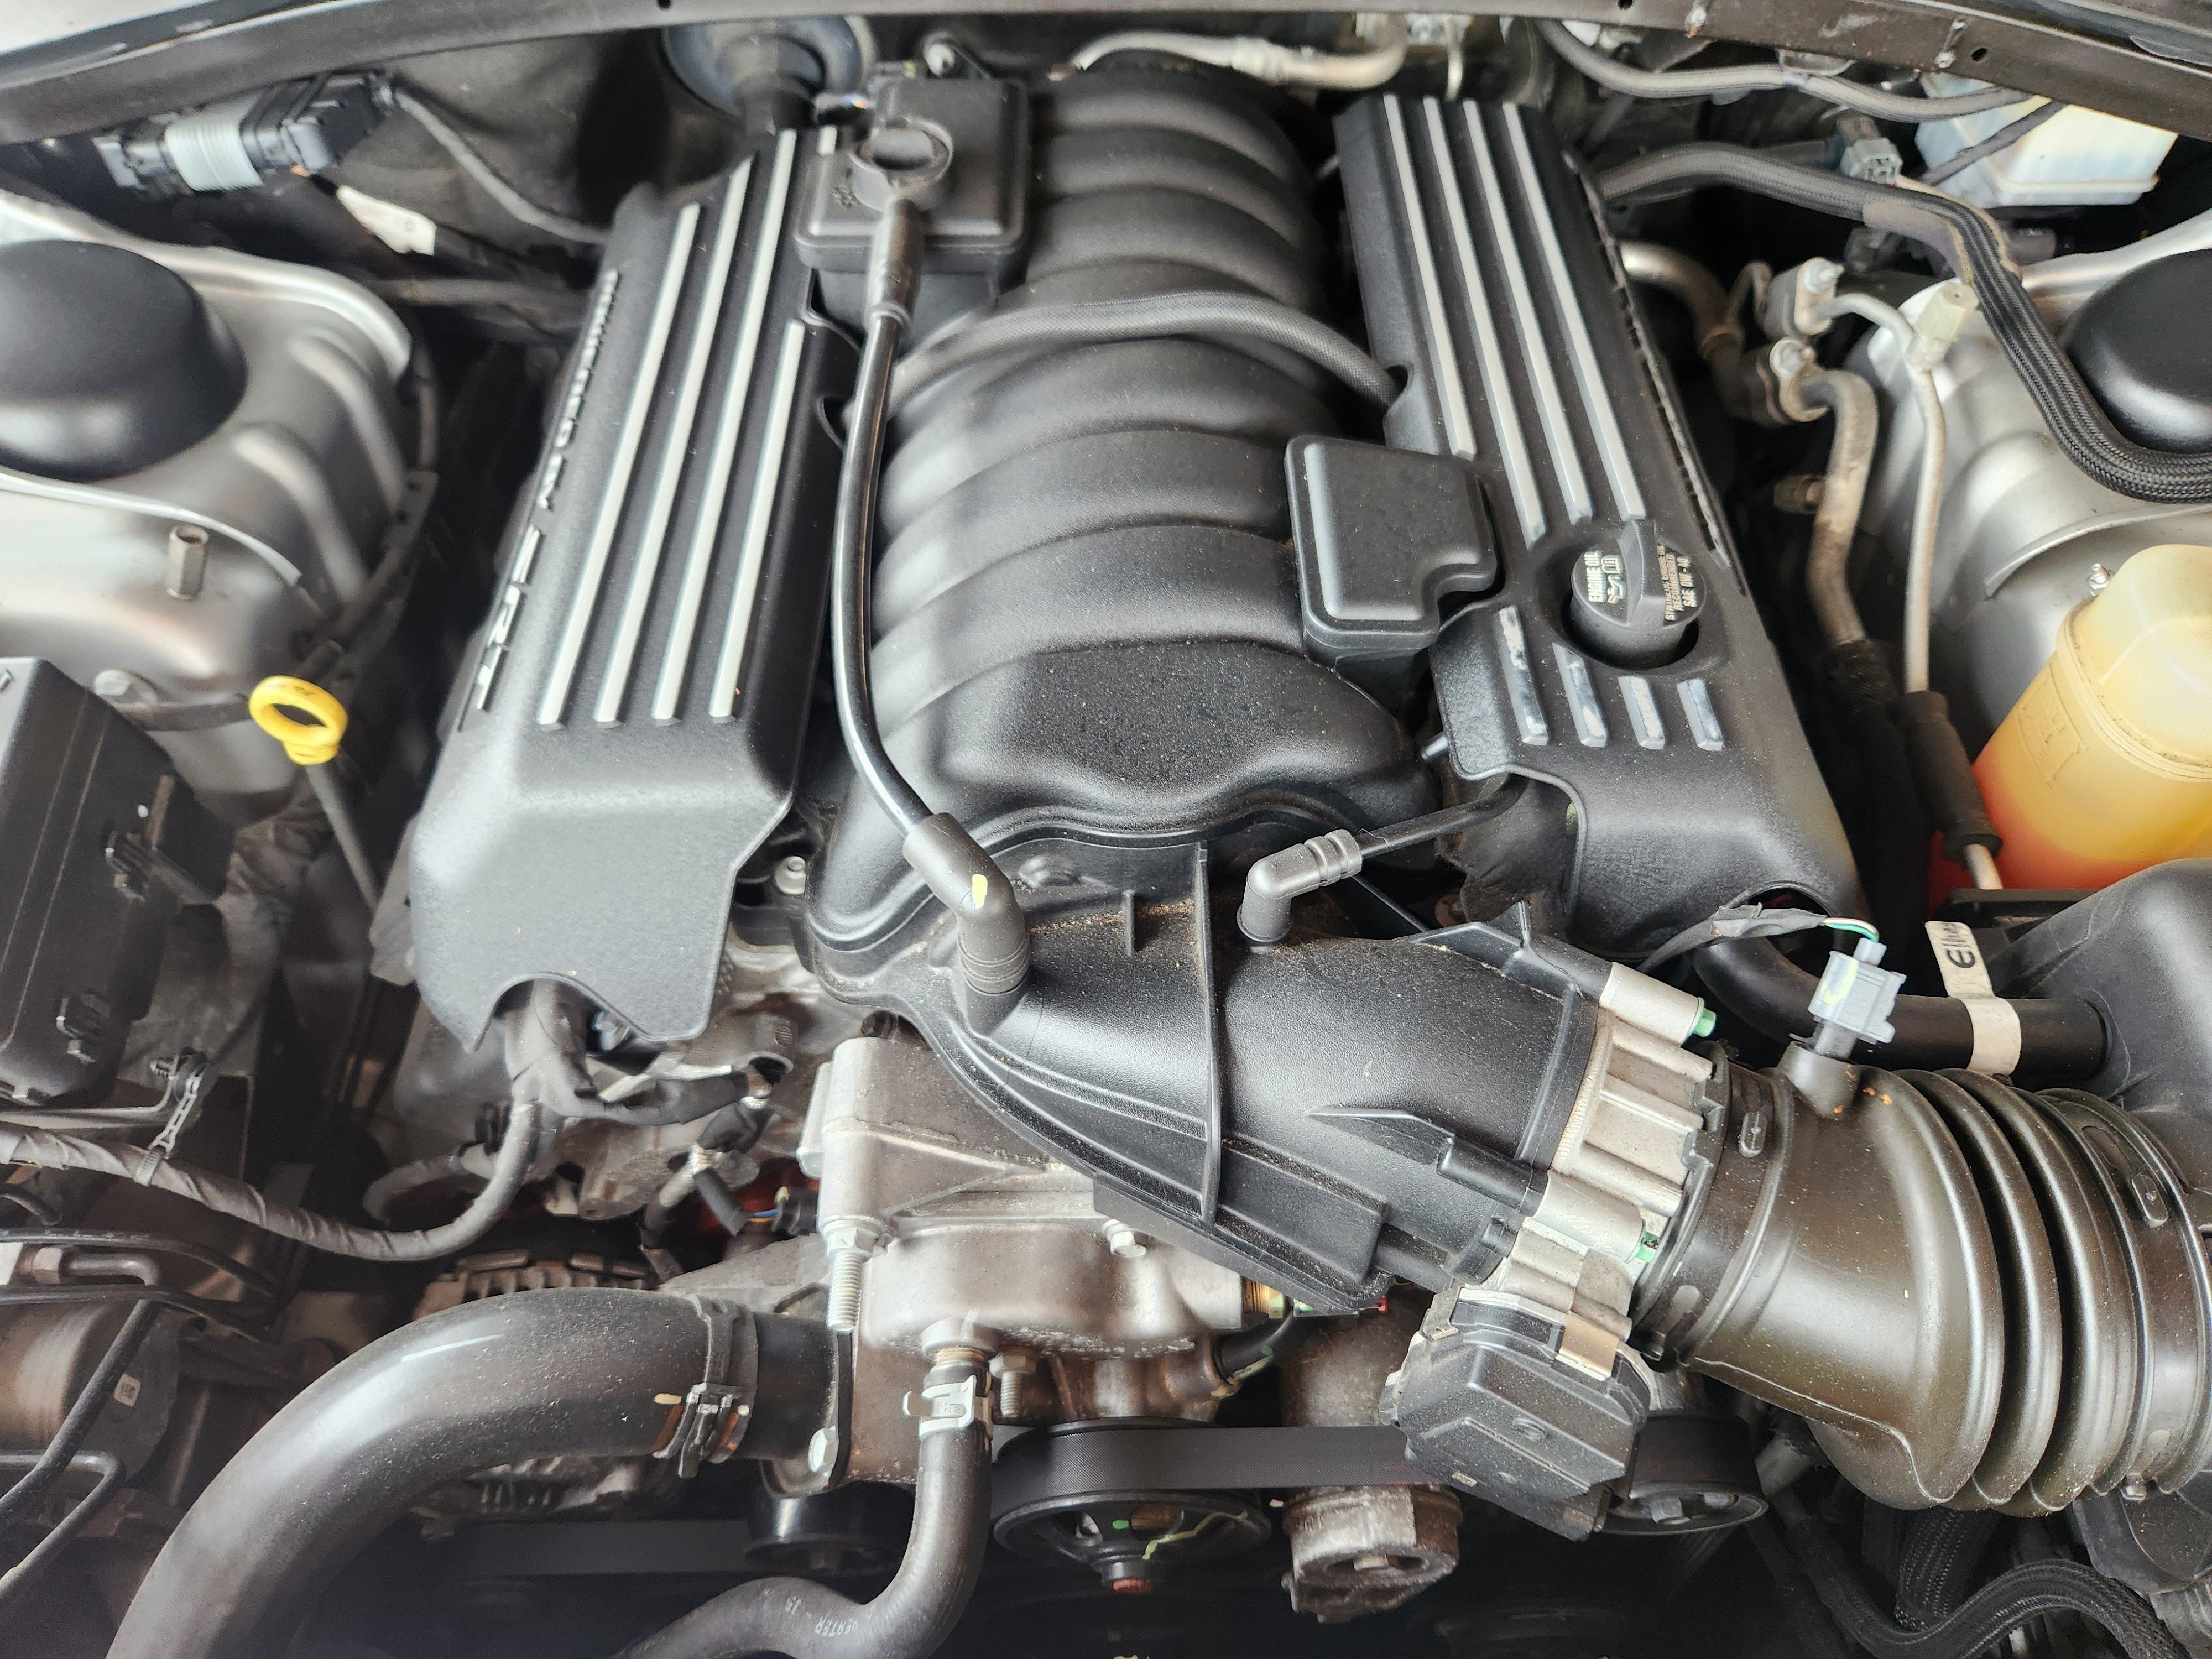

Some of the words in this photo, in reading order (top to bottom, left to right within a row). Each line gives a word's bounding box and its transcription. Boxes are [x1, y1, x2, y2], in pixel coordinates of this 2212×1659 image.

[536, 453, 563, 509] BY
[1584, 553, 1600, 566] OIL
[1586, 567, 1604, 603] ENGINE
[1666, 554, 1684, 611] RECOMMENDED
[1682, 588, 1697, 607] SAE
[476, 523, 541, 710] SRT
[815, 1614, 858, 1637] HEATER
